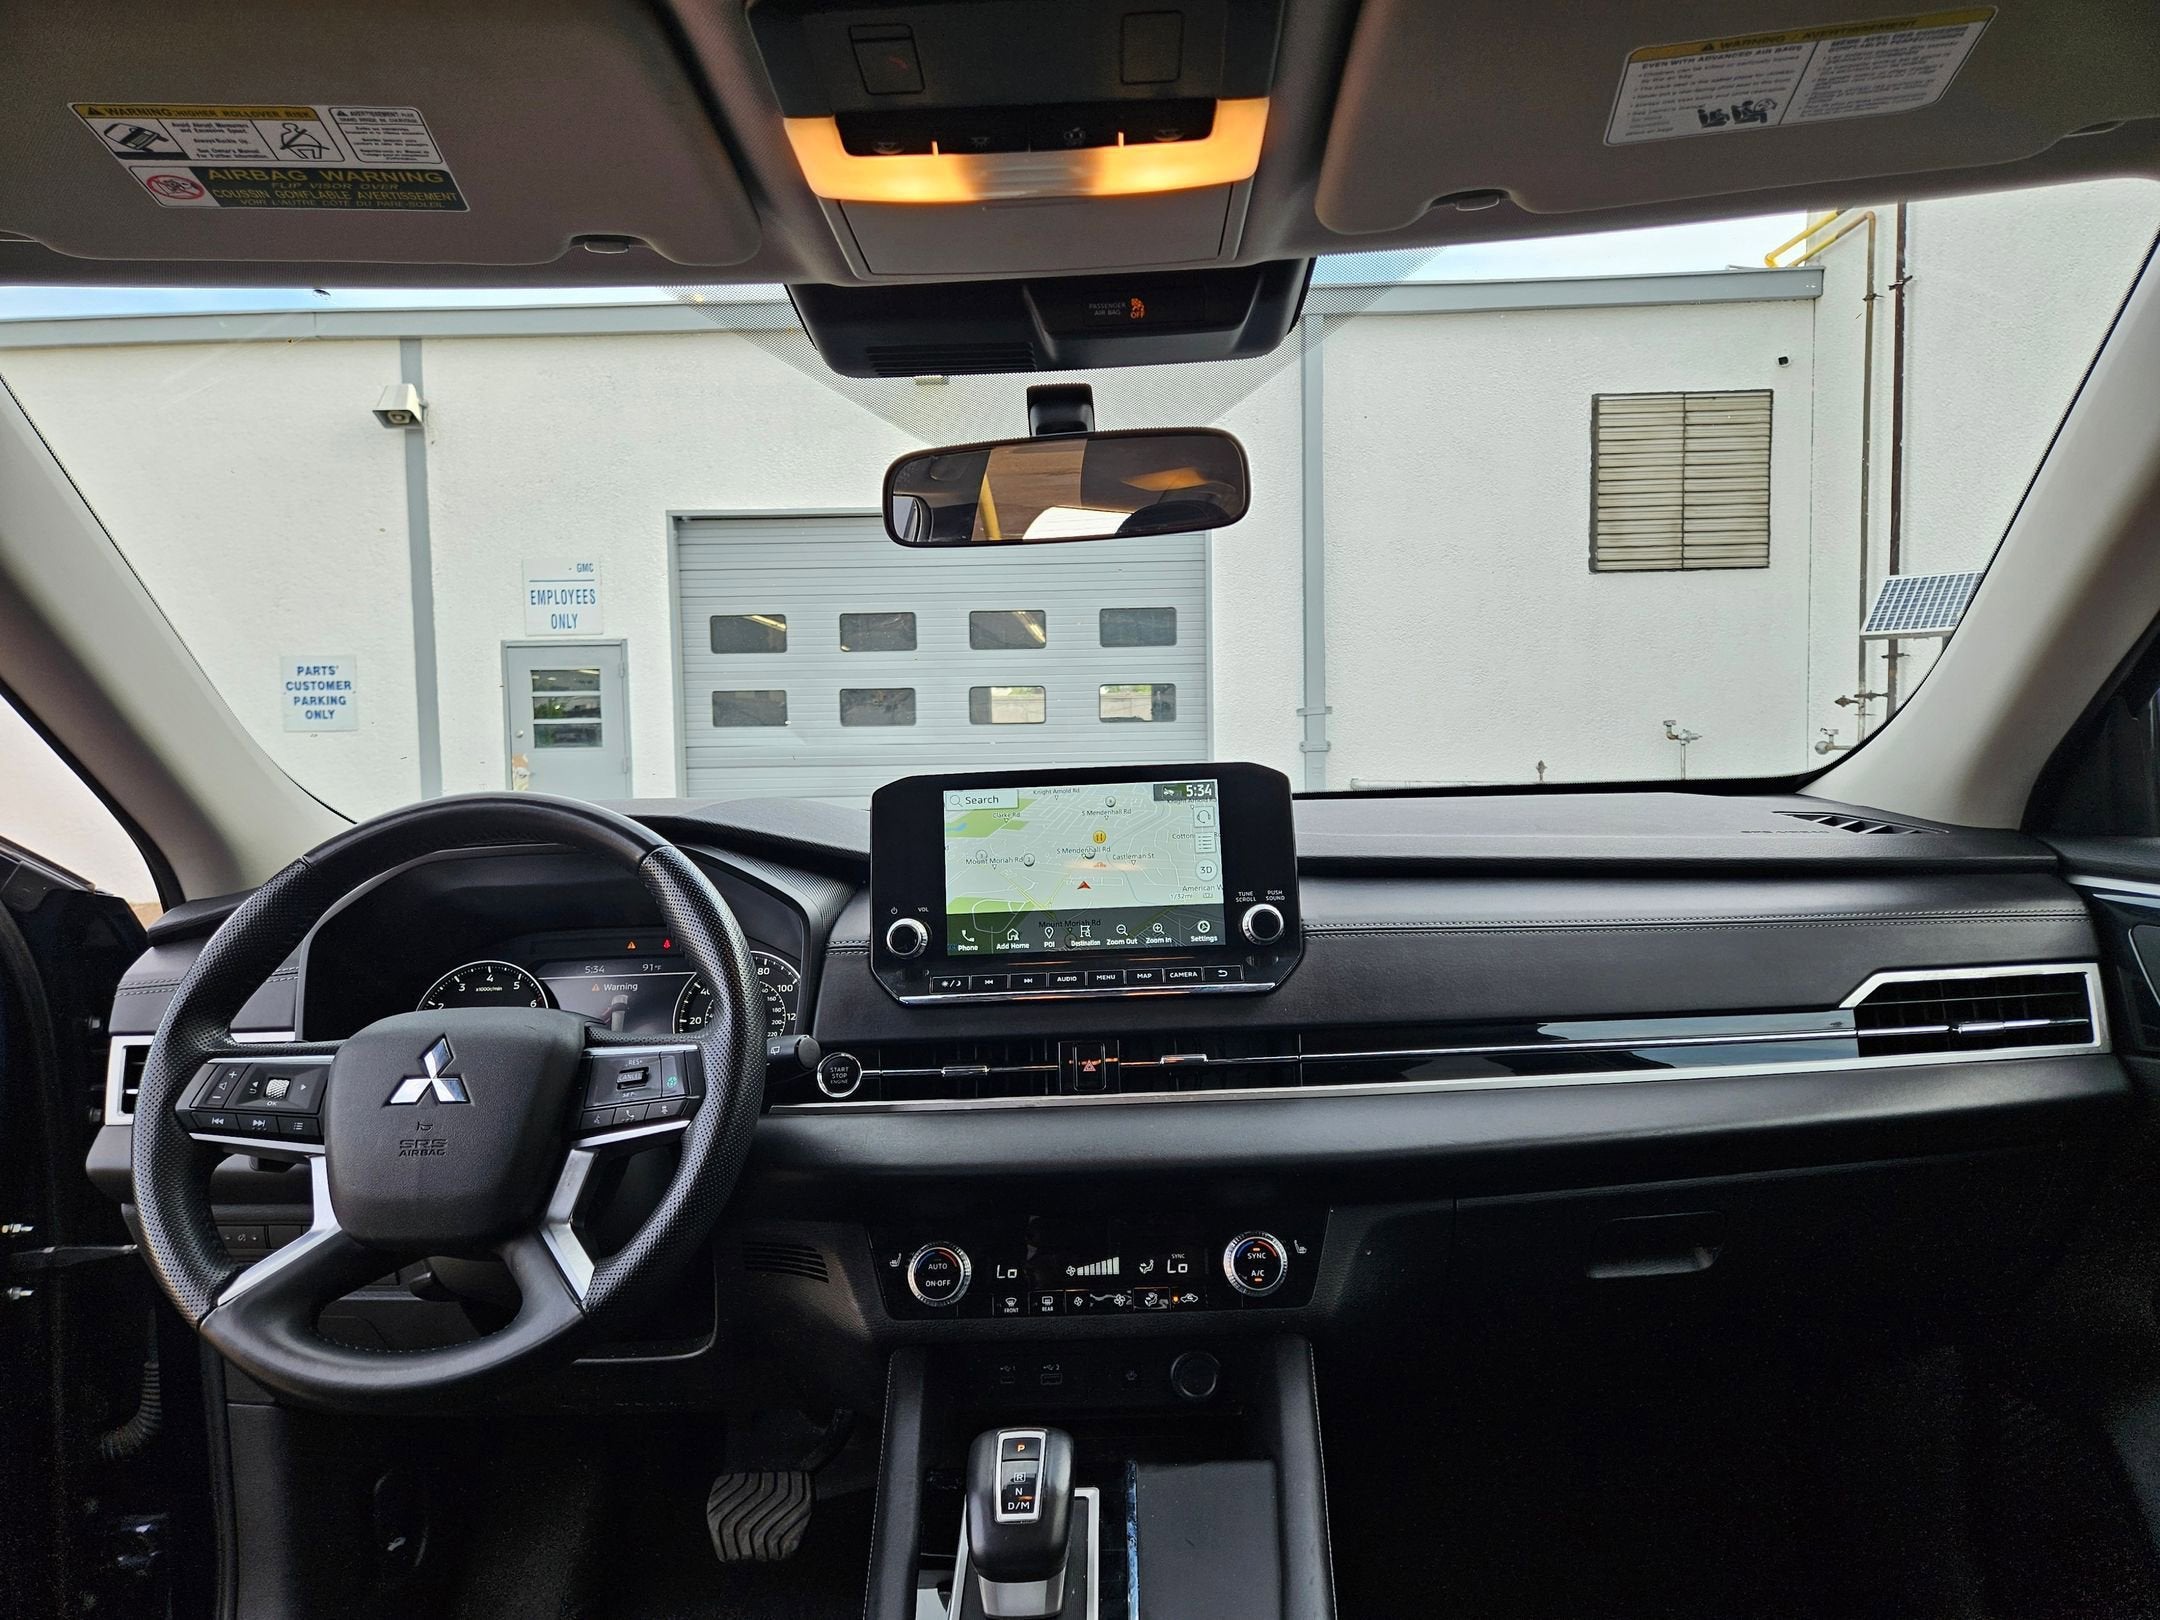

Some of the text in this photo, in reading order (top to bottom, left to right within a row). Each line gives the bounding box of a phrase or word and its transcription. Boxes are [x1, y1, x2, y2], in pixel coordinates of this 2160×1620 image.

[208, 169, 444, 183] AIRBAG WARNING
[212, 189, 456, 201] COUSSIN GONFLABLE AVERTISSEMENT
[576, 562, 594, 573] GMC
[530, 588, 596, 605] EMPLOYEES
[551, 613, 578, 629] ONLY
[285, 680, 352, 691] CUSTOMER
[293, 695, 347, 706] PARKING
[305, 709, 336, 720] ONLY
[1033, 788, 1052, 796] Knight
[1186, 783, 1212, 797] 5:34
[965, 795, 999, 805] Search
[1171, 832, 1195, 840] Cotton
[1061, 846, 1100, 854] Mendenhall
[989, 856, 1013, 864] Moriah
[1200, 866, 1213, 874] 3D
[1182, 884, 1215, 892] American
[1038, 920, 1062, 928] Mount
[1064, 919, 1090, 927] Moriah
[1070, 939, 1101, 947] Destination
[1145, 936, 1163, 944] Zoom
[1190, 934, 1218, 943] Settings
[957, 943, 979, 951] Phone
[1043, 940, 1055, 948] POI
[584, 965, 605, 974] 5:34
[757, 966, 770, 975] 80
[486, 974, 494, 982] 4
[458, 983, 466, 992] 3
[513, 981, 520, 990] 5
[603, 983, 638, 992] Warning
[777, 984, 793, 992] 100
[530, 999, 537, 1008] 6
[689, 1016, 702, 1025] 20
[786, 1012, 797, 1021] 12
[399, 1138, 448, 1149] SRS
[398, 1149, 447, 1157] AIRBAG
[1247, 1252, 1267, 1260] SYNC
[928, 1263, 948, 1271] AUTO
[1251, 1269, 1265, 1278] A/C
[1017, 1444, 1025, 1453] P
[1015, 1487, 1023, 1496] N
[1007, 1502, 1030, 1511] D/M
